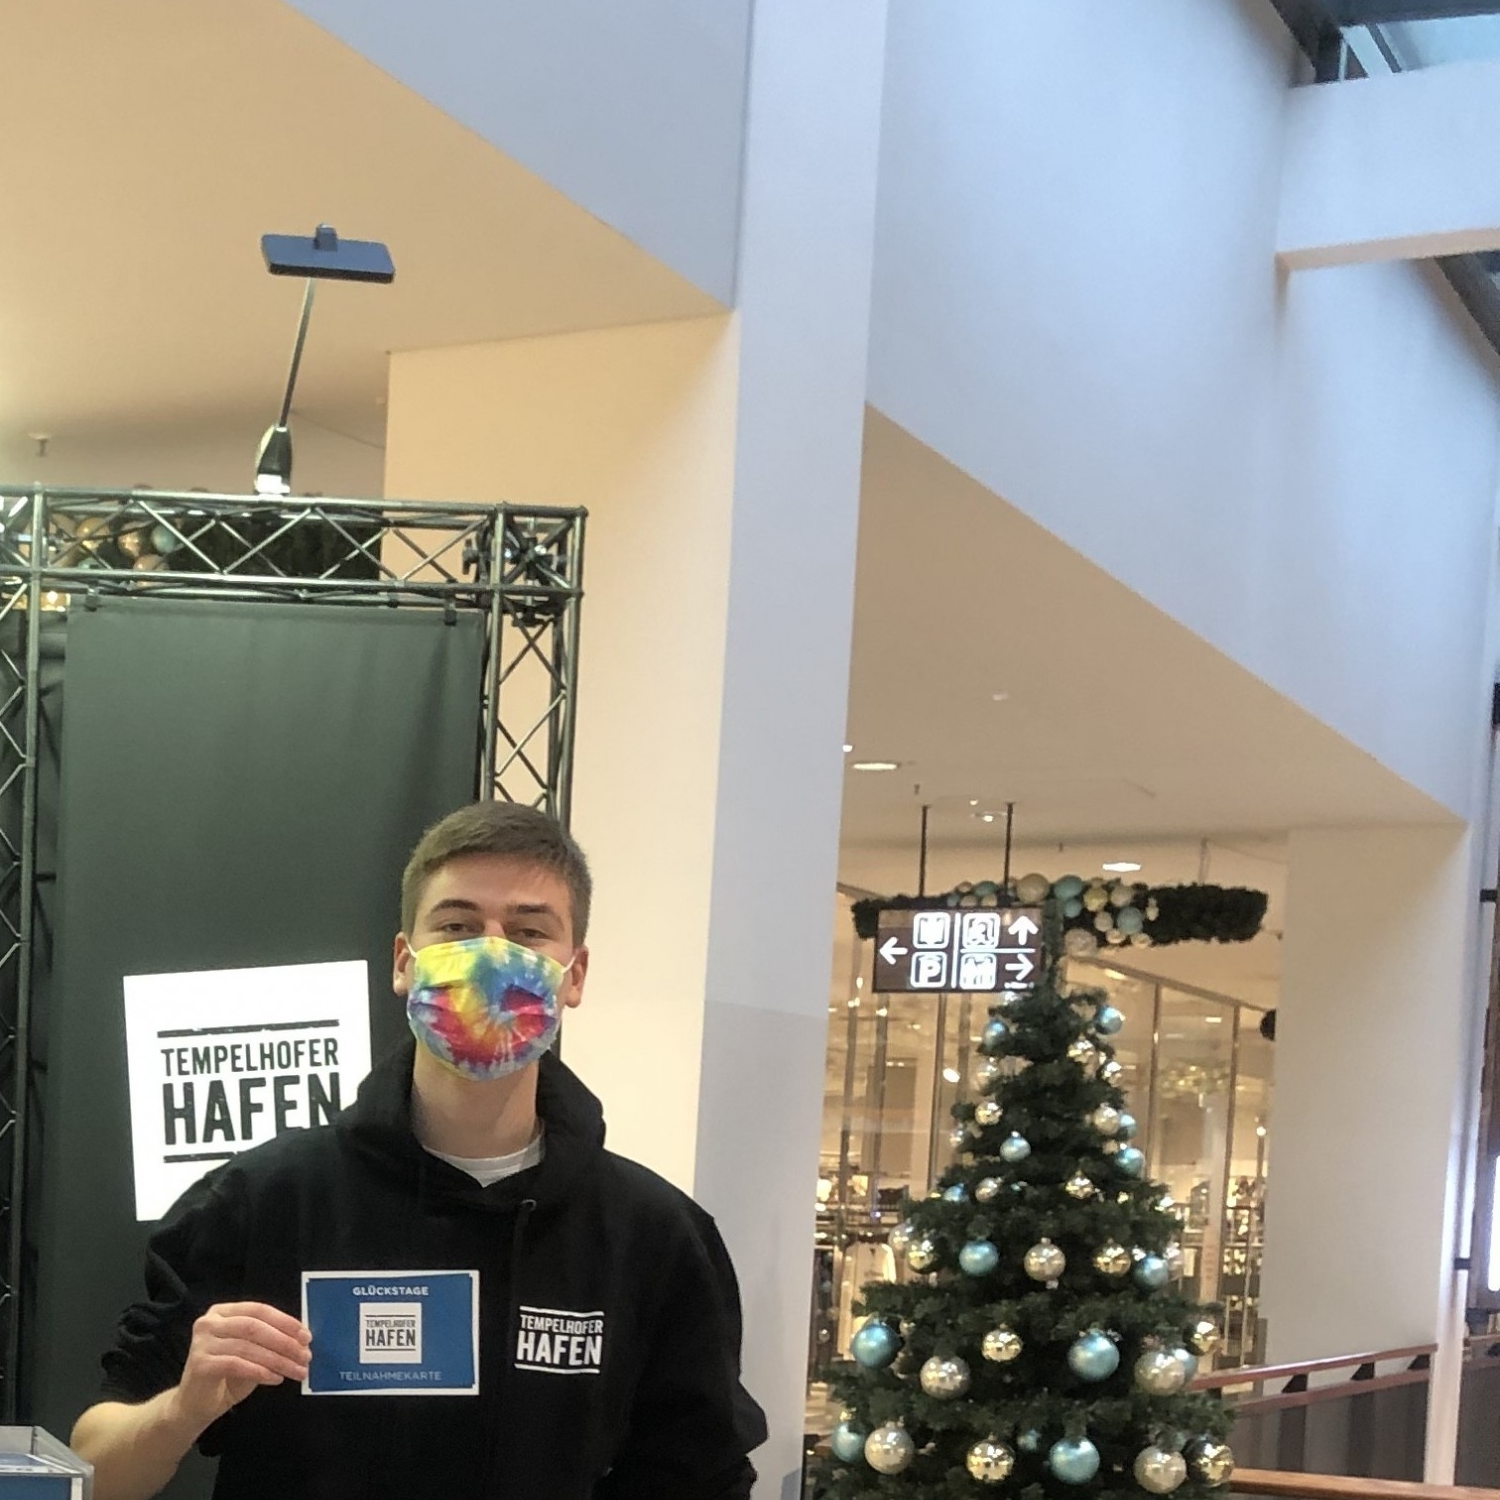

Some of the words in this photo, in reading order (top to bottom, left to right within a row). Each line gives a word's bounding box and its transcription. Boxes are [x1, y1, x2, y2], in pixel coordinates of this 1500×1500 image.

[161, 1037, 339, 1076] TEMPELHOFER
[162, 1071, 341, 1145] HAFEN
[352, 1284, 429, 1296] GLÜCKSTAGE
[520, 1314, 604, 1334] TEMPELHOFER
[365, 1329, 416, 1347] HAFEN
[516, 1330, 603, 1366] HAFEN
[339, 1370, 442, 1381] TEILNAHMEKARTE
